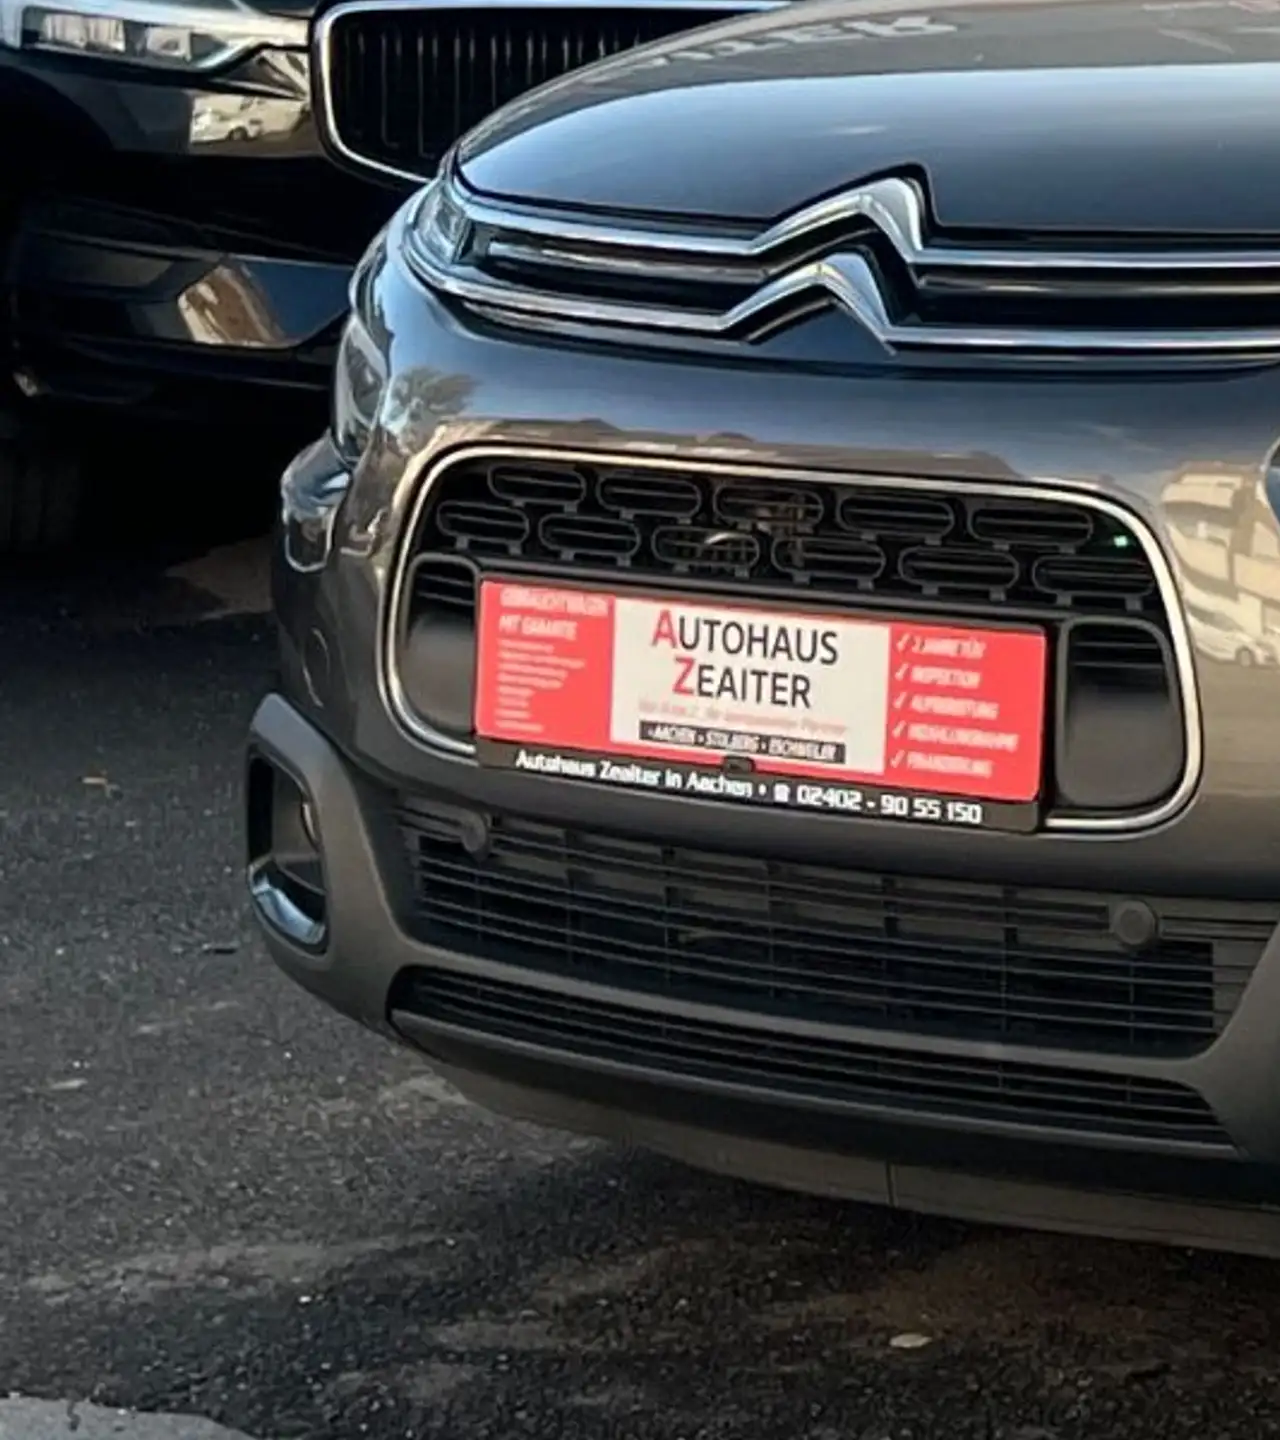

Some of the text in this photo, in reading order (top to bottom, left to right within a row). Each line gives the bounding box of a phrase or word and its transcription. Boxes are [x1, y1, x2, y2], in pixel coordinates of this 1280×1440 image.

[651, 610, 839, 665] AUTOHAUS
[672, 656, 811, 709] ZEAITER
[516, 749, 982, 825] Autohaus Zeaiter in Aachen 02402 90 55 150
